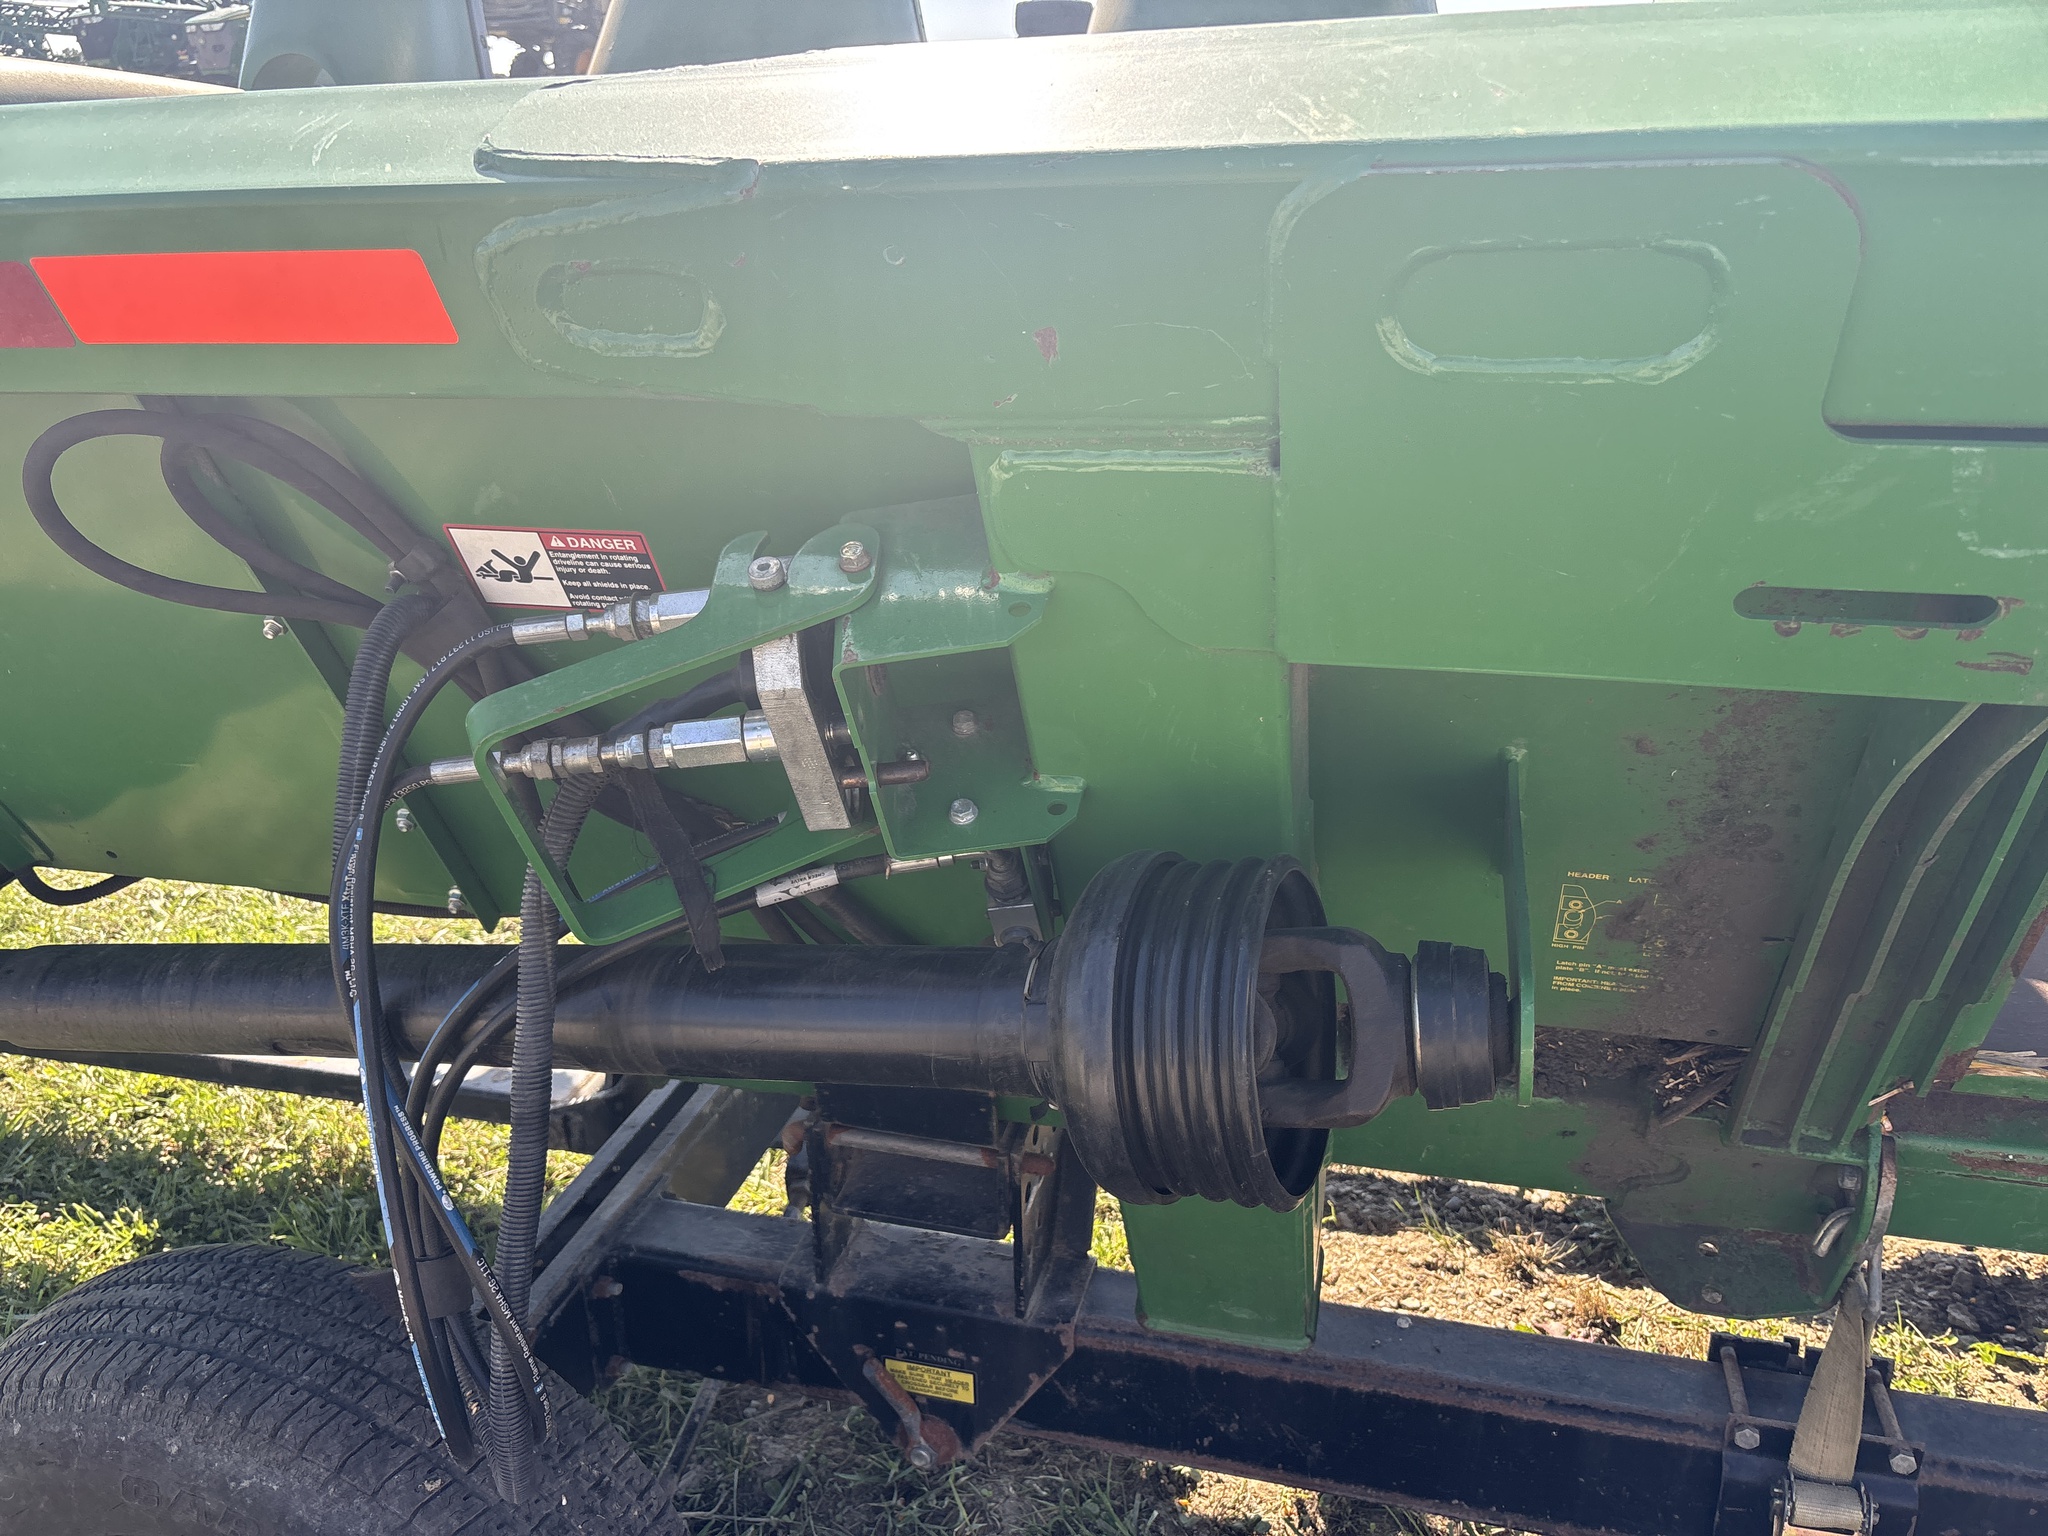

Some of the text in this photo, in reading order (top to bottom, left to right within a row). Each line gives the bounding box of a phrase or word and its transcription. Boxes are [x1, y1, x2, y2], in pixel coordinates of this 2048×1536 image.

[566, 537, 637, 551] DANGER
[548, 551, 600, 560] Entanglement
[610, 555, 639, 563] rotating
[552, 559, 584, 567] driveline
[624, 562, 651, 570] serious
[556, 566, 577, 574] injury
[587, 567, 611, 575] death.
[562, 580, 581, 588] Keep
[572, 600, 601, 608] rotating
[1567, 871, 1610, 880] HEADER
[340, 903, 351, 950] 4M3K-XTF
[1553, 976, 1599, 985] IMPORTANT:
[418, 1151, 443, 1191] POWERING
[477, 1258, 500, 1293] 2G-11C
[494, 1292, 512, 1320] MSHA
[510, 1316, 531, 1359] Resistant
[919, 1352, 961, 1366] PENDING
[528, 1356, 541, 1383] Flame
[906, 1364, 951, 1377] IMPORTANT
[907, 1386, 953, 1398] TRANSPORTING
